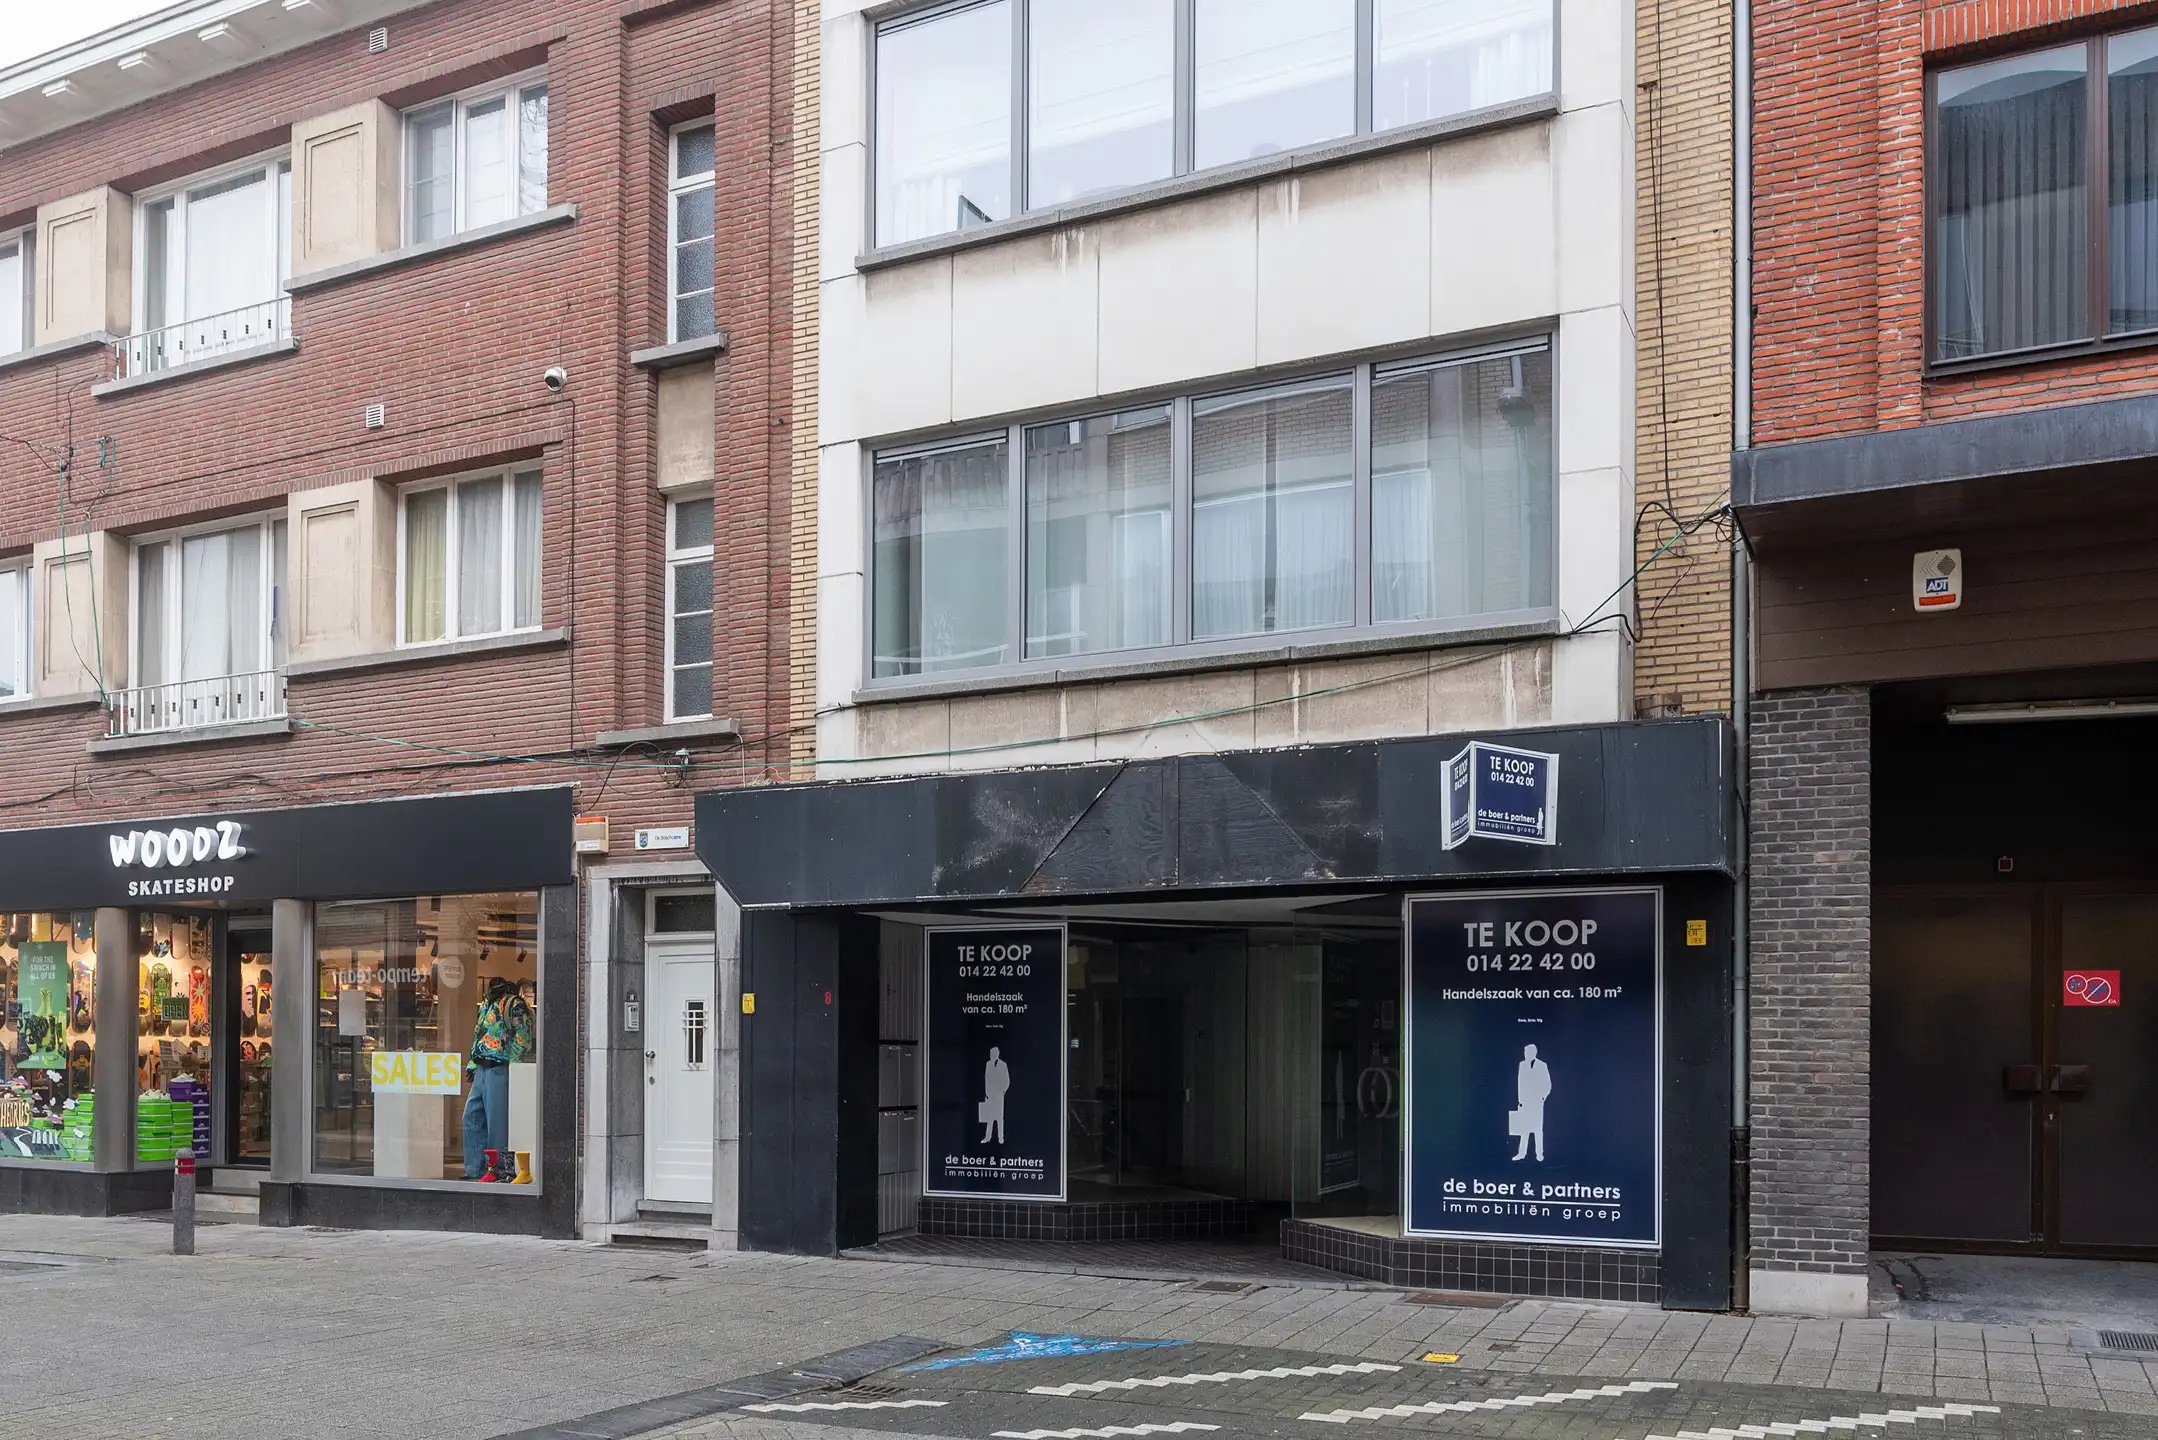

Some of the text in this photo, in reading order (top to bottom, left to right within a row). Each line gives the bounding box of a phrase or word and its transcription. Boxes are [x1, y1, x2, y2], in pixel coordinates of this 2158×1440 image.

[1926, 579, 1949, 592] ADT
[1490, 756, 1534, 775] TE KOOP
[1491, 772, 1534, 786] 014 22 42 00
[1478, 809, 1486, 817] de
[1489, 810, 1503, 819] boer
[1510, 814, 1535, 824] partners
[109, 820, 247, 868] WOODZ
[128, 876, 235, 897] SKATESHOP
[1464, 920, 1597, 947] TE KOOP
[958, 945, 1031, 961] TE KOOP
[1467, 953, 1595, 971] 014 22 42 00
[960, 965, 1030, 977] 014 22 42 00
[967, 992, 1023, 1001] Handelszaak
[1443, 988, 1522, 999] Handelszaak
[1526, 990, 1549, 998] van
[1554, 990, 1574, 998] ca.
[1579, 987, 1600, 998] 180
[999, 1004, 1013, 1013] 180
[373, 1053, 460, 1087] SALES
[946, 1155, 1043, 1169] de boer & partners
[945, 1168, 1006, 1177] immobiliën
[1444, 1178, 1620, 1199] de boer & partners
[1443, 1201, 1620, 1221] immobiliën groep
